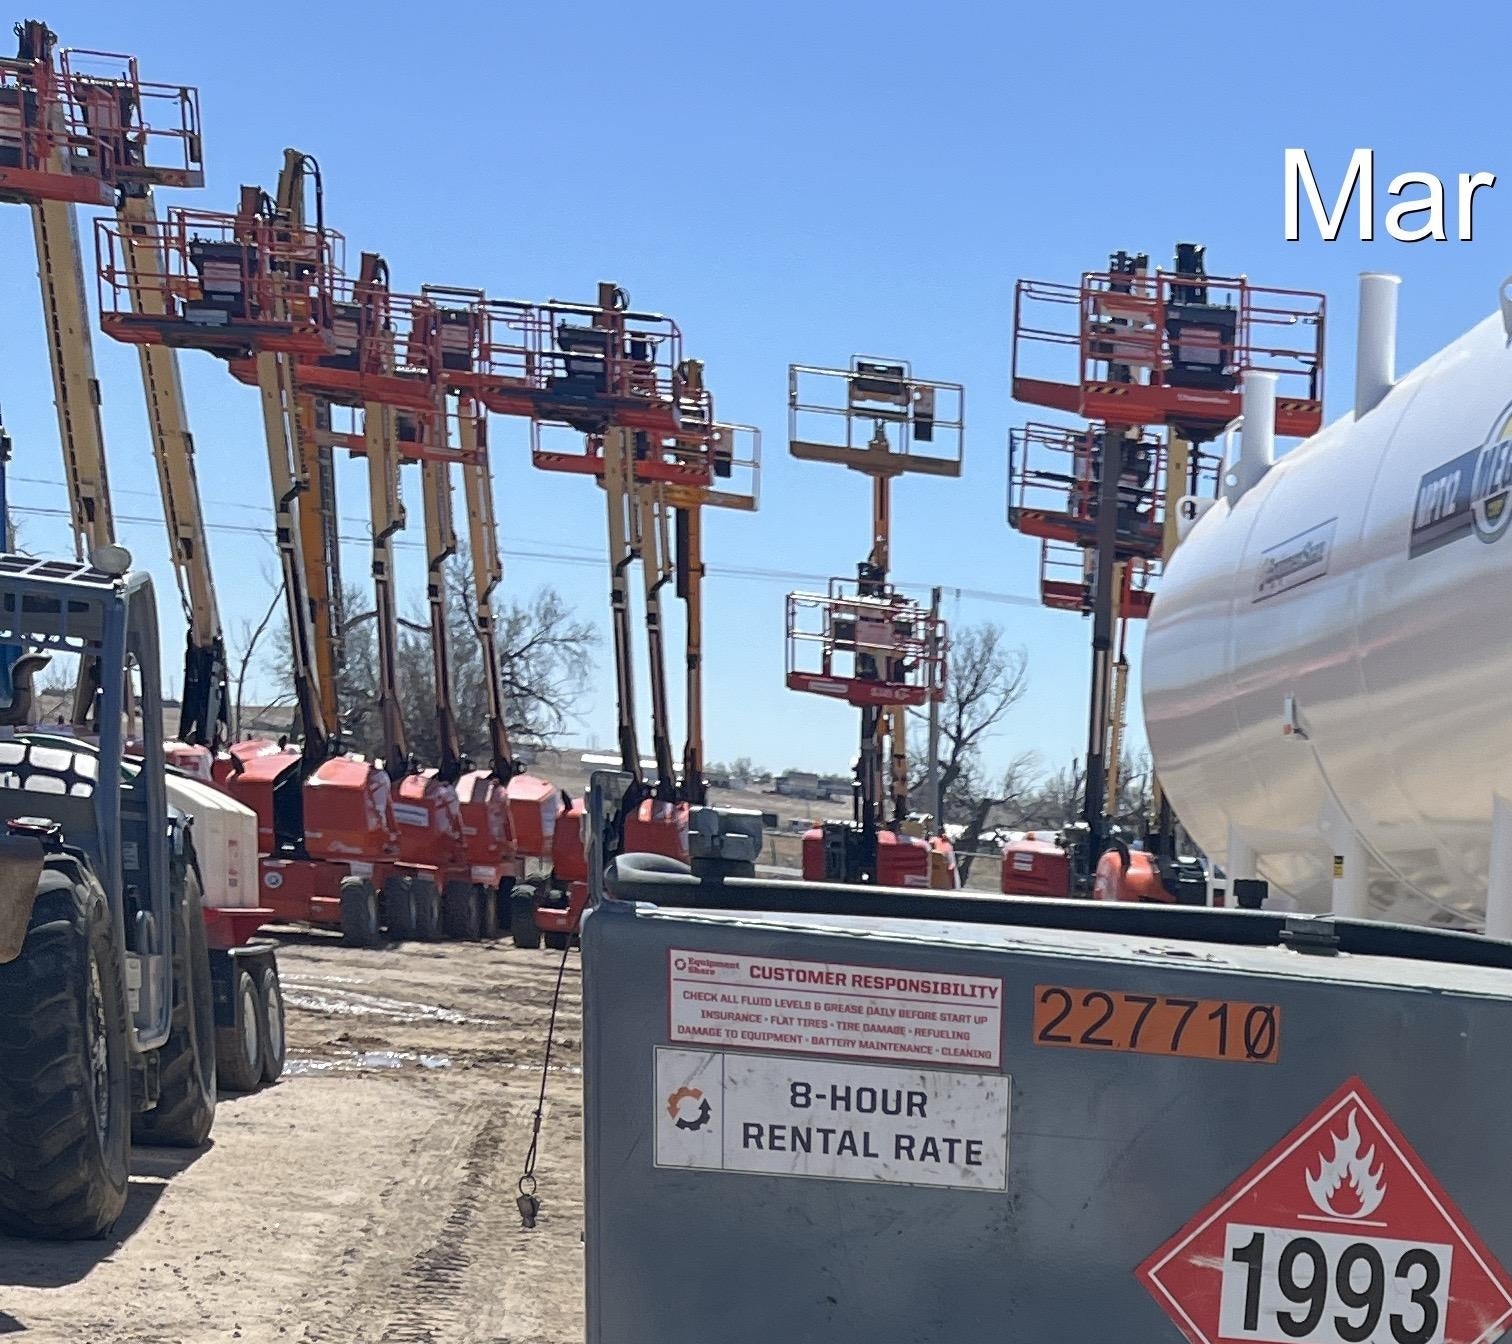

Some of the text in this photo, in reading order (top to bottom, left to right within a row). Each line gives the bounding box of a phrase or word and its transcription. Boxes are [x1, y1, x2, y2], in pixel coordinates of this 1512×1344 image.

[749, 965, 998, 999] CUSTOMER RESPONSIBILITY
[683, 990, 718, 1003] CHECK
[721, 994, 739, 1004] ALL
[741, 995, 772, 1007] FLUID
[775, 998, 811, 1010] LEVELS
[824, 1003, 863, 1015] GREASE
[866, 1006, 896, 1018] DAILY
[899, 1009, 936, 1021] BEFORE
[939, 1012, 971, 1024] START
[974, 1016, 987, 1025] UP
[701, 1009, 970, 1041] INSURANCE FLAT TIRES TIRE DAMAGE REFUELING
[1038, 988, 1276, 1059] 227710
[677, 1025, 992, 1059] DAMAGE TO EQUIPMENT BATTERY MAINTENANCE CLEANING
[789, 1080, 928, 1118] 8-HOUR
[742, 1122, 983, 1166] RENTAL RATE
